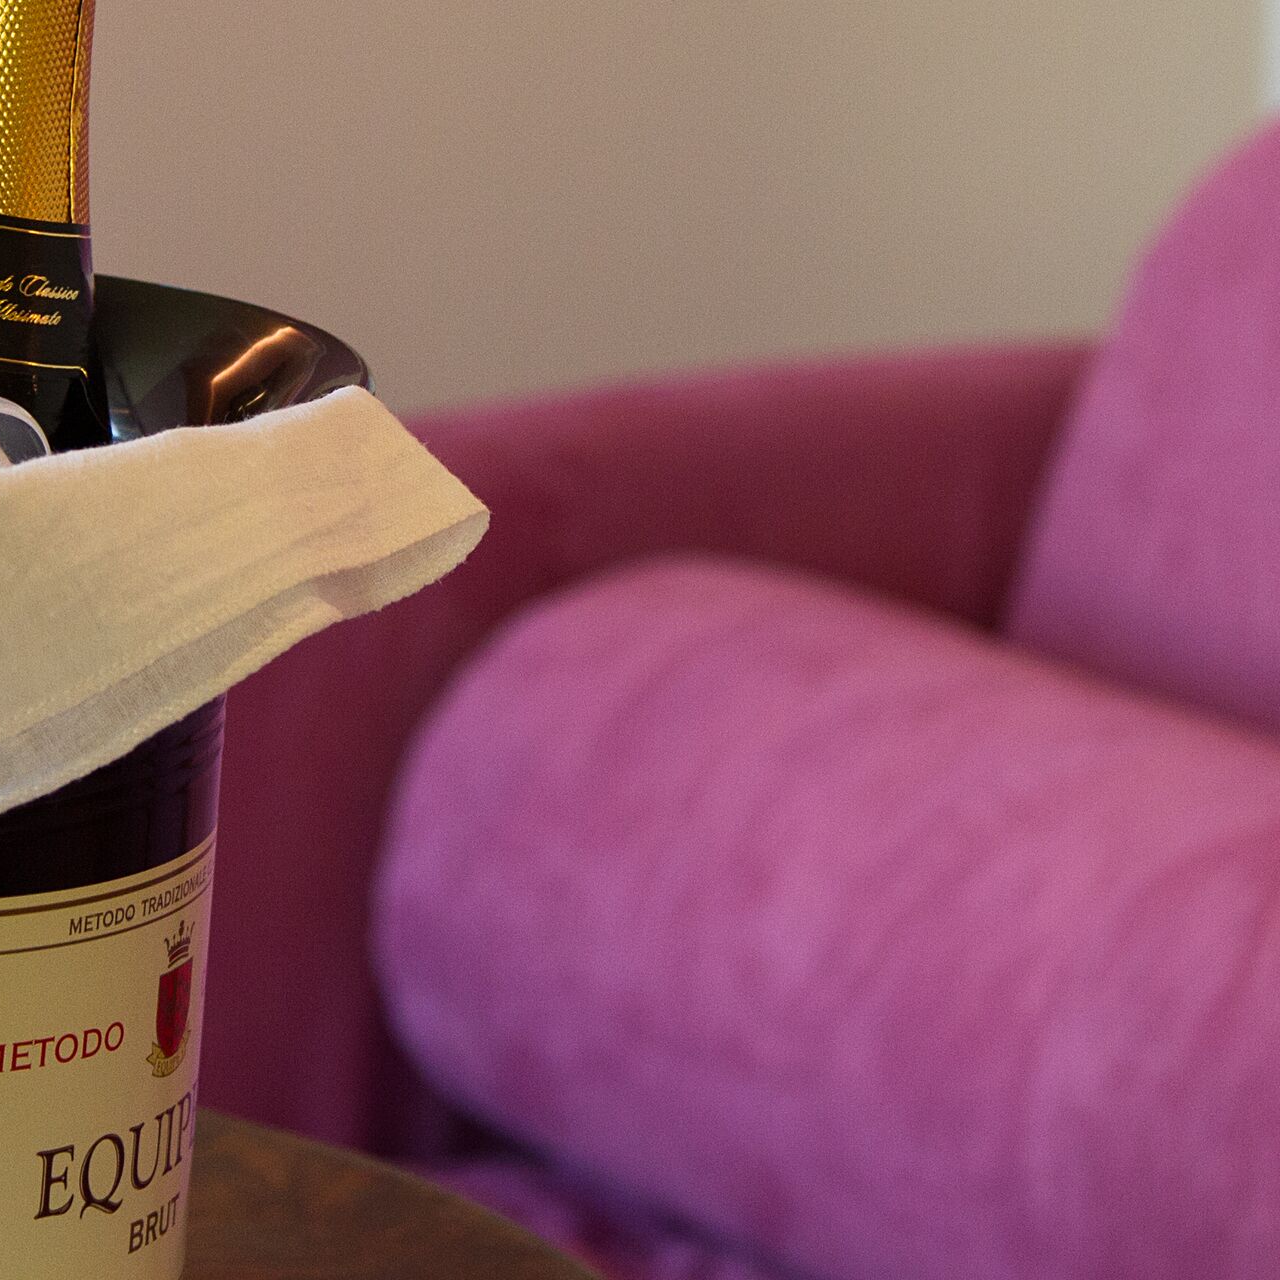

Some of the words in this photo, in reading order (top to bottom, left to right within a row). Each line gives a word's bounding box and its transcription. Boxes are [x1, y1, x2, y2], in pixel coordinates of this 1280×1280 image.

[20, 275, 79, 300] Classico
[68, 904, 136, 936] METODO
[127, 1192, 179, 1254] BRUT
